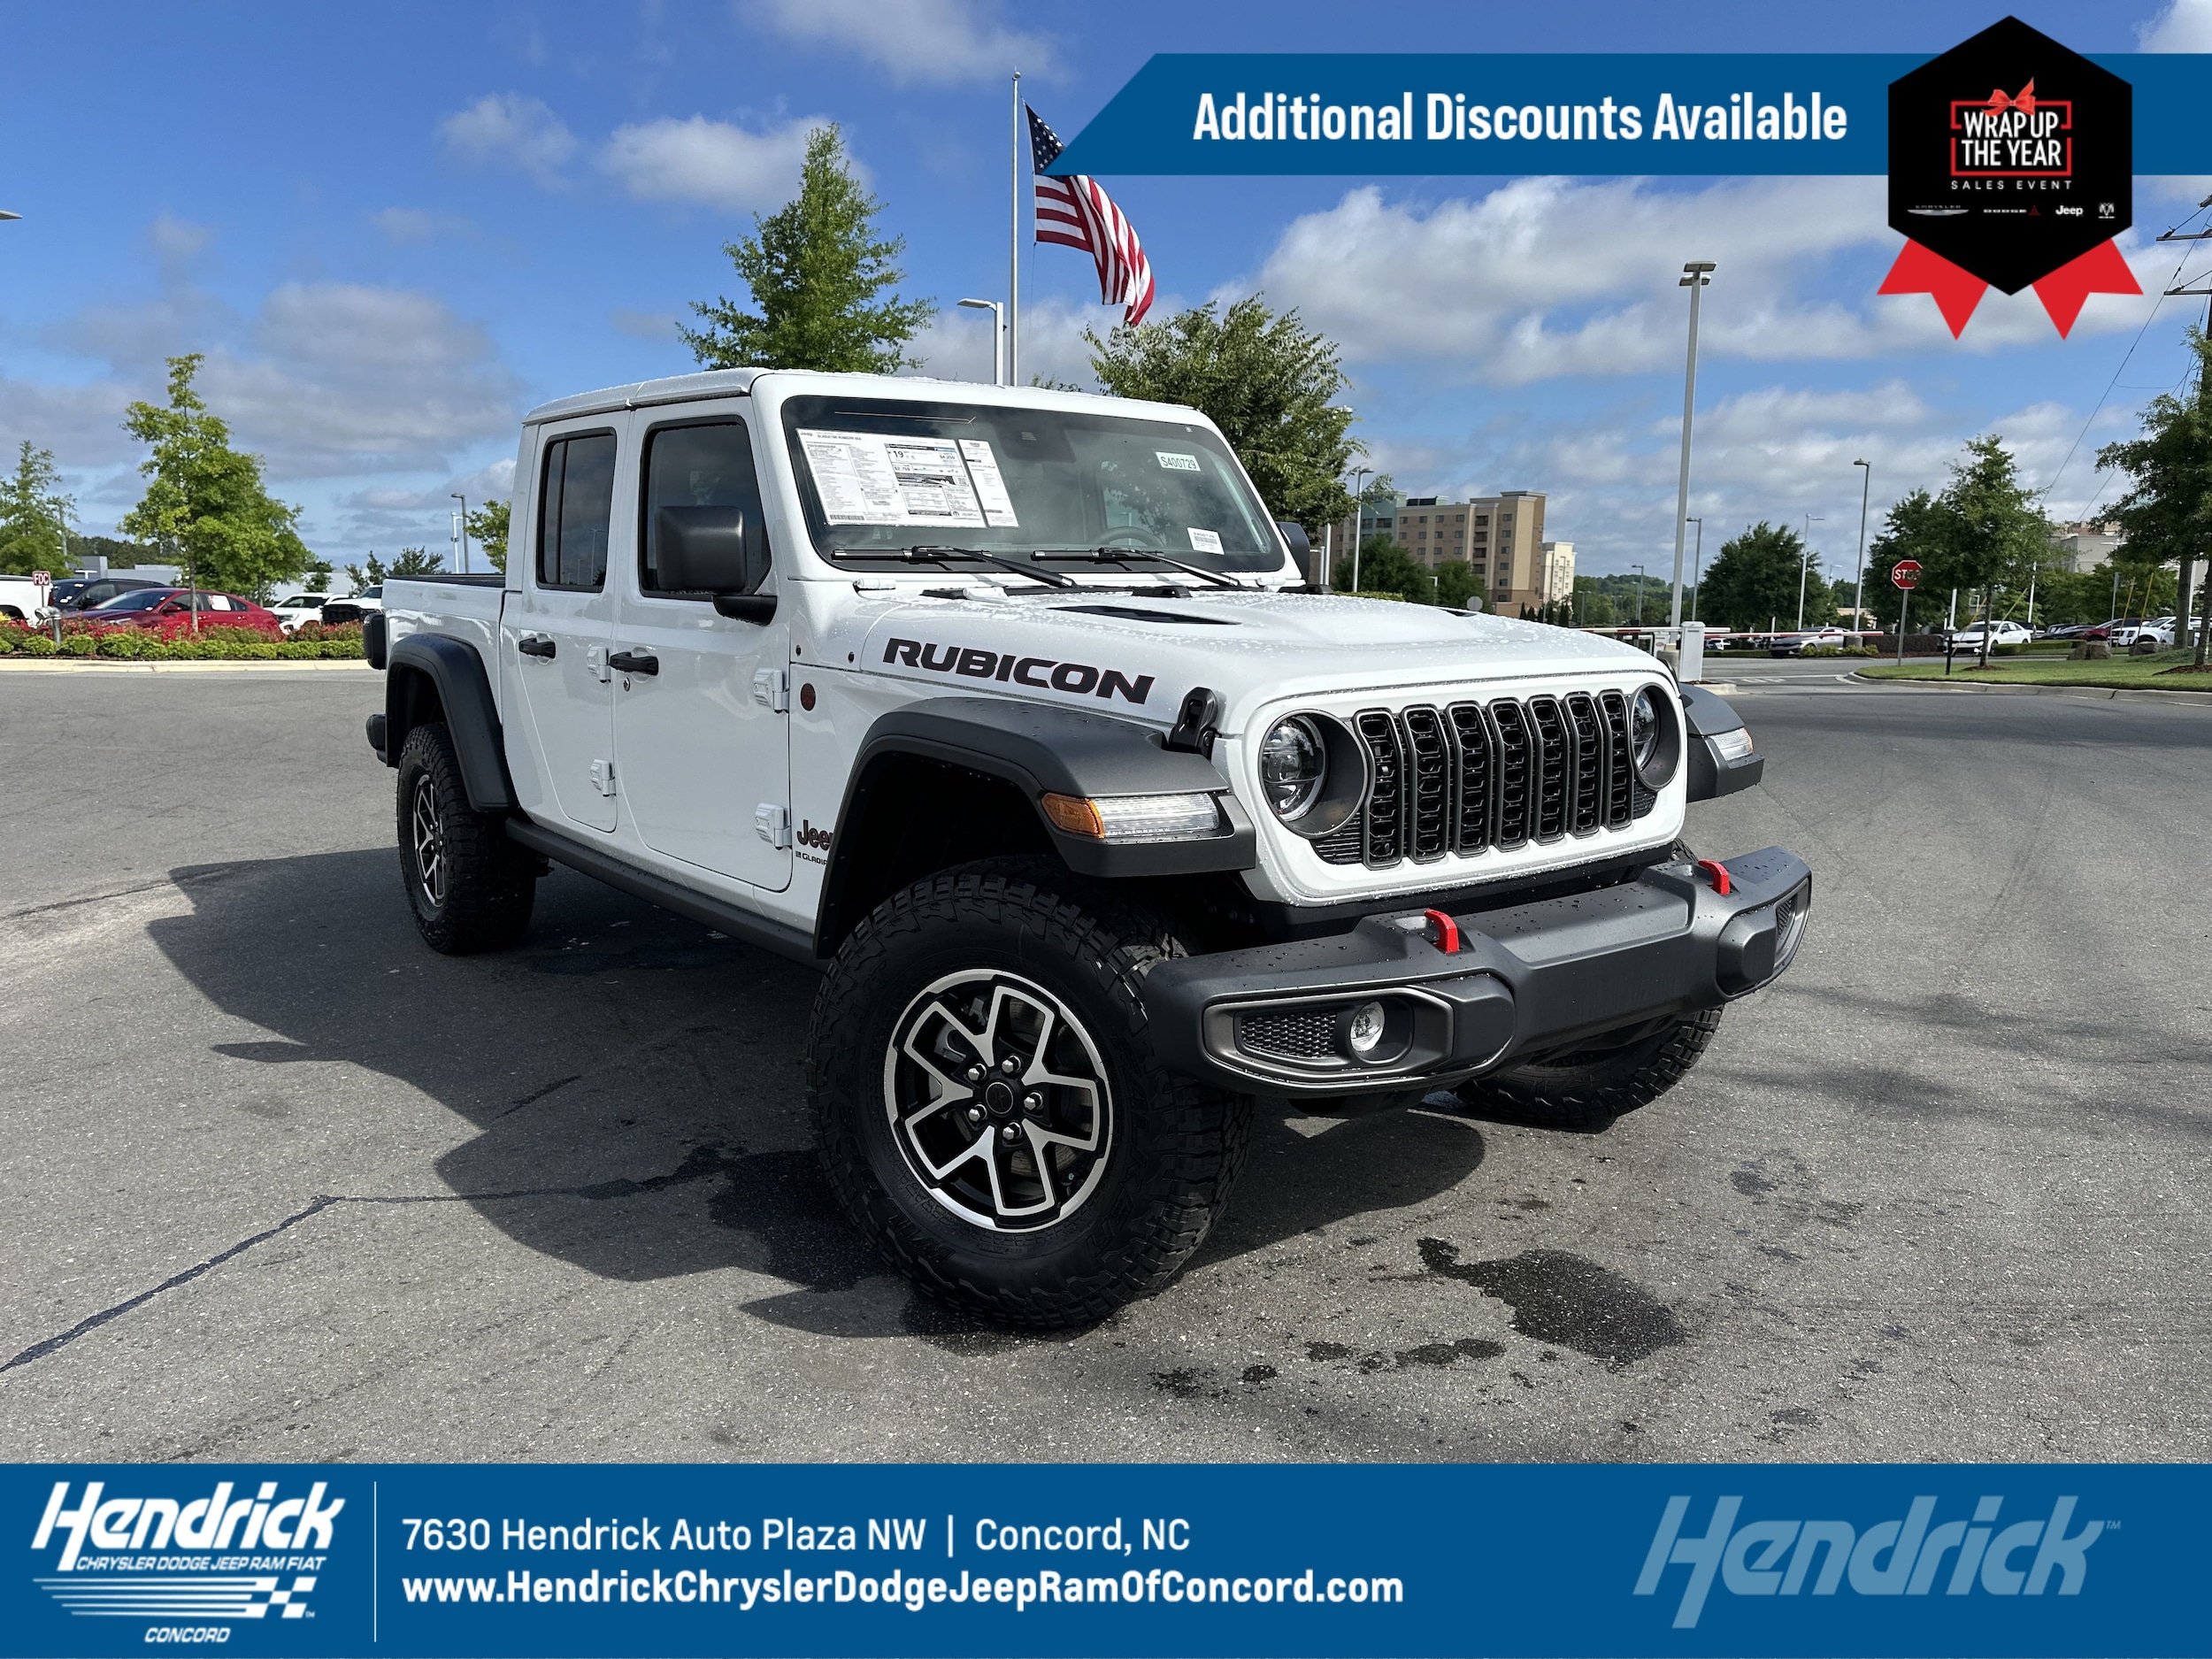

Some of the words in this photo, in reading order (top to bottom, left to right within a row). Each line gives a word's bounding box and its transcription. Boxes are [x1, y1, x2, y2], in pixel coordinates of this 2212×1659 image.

[1160, 456, 1197, 470] S400729
[34, 572, 49, 585] FDC
[882, 637, 1156, 705] RUBICON
